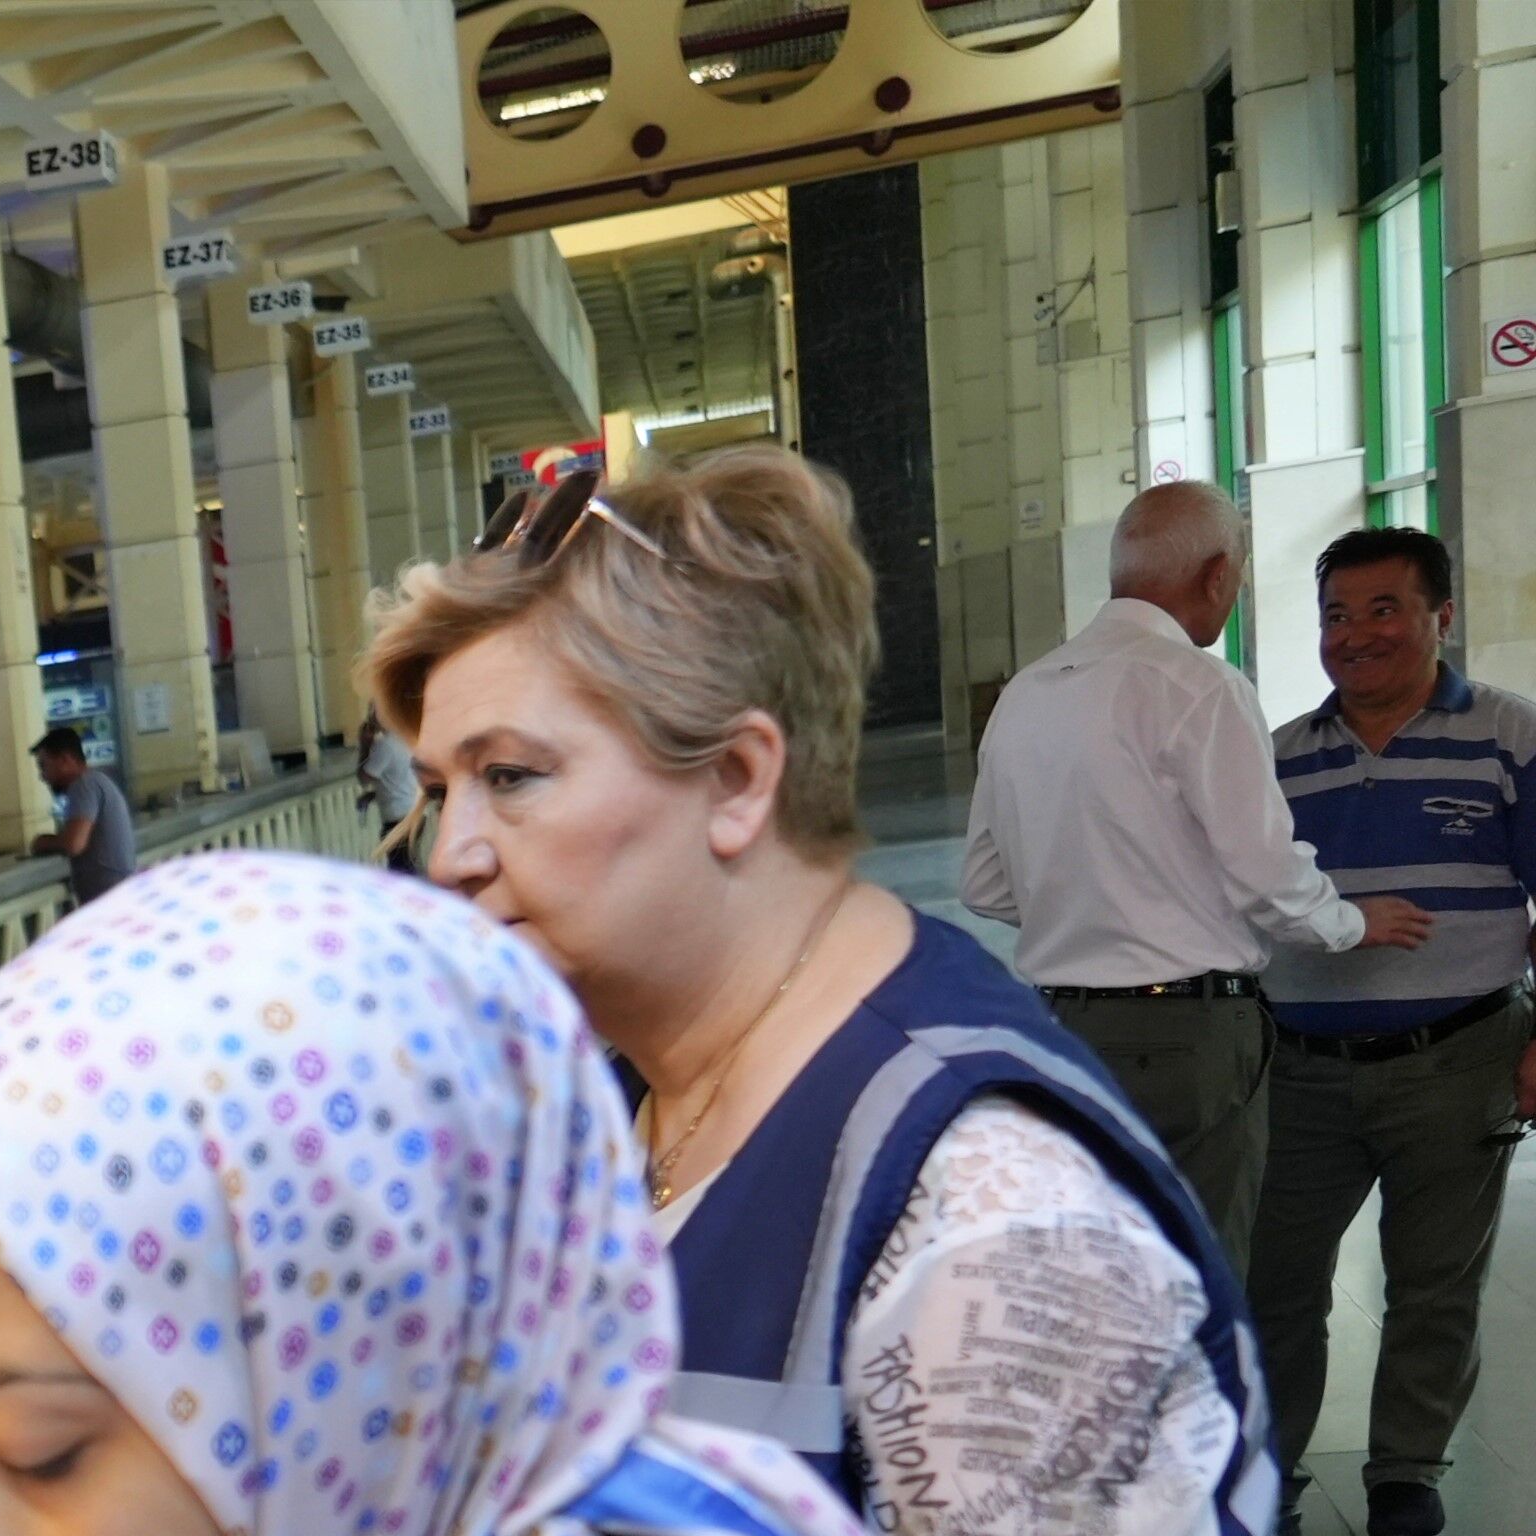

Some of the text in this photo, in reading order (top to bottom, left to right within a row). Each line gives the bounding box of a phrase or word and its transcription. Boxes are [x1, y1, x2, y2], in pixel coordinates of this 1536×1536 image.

[26, 139, 101, 176] EZ-38
[163, 240, 224, 269] EZ-37
[249, 289, 301, 313] EZ-36
[316, 323, 362, 346] EZ-35
[861, 1332, 950, 1509] FASHION
